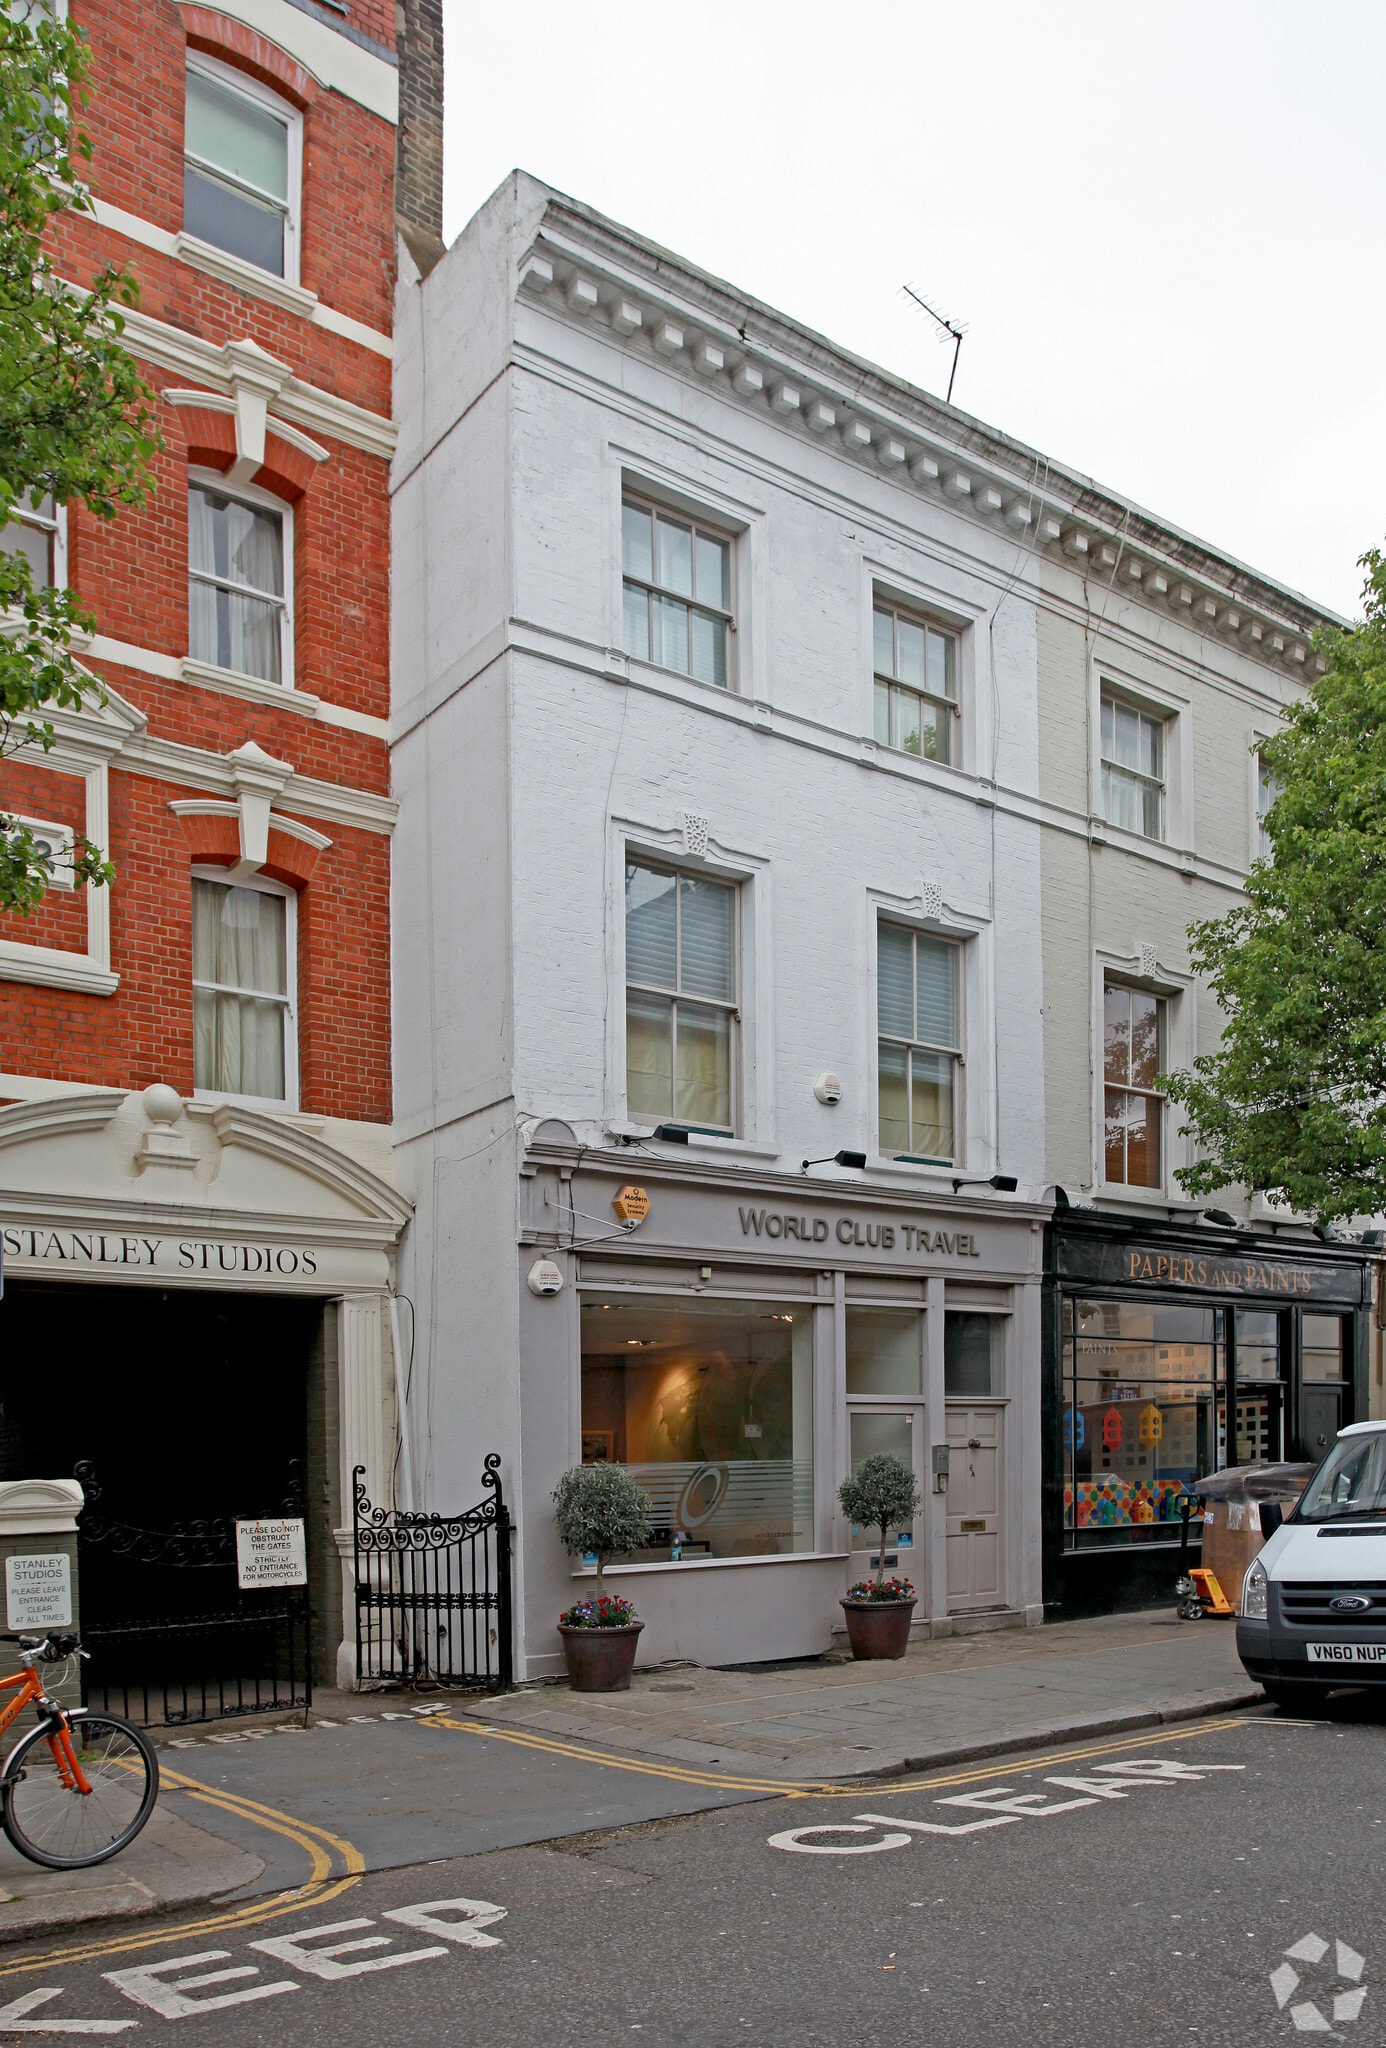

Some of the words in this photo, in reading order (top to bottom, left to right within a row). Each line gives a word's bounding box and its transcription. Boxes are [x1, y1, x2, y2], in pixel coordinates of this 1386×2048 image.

[624, 1193, 648, 1203] Modern
[626, 1202, 645, 1210] Security
[738, 1206, 830, 1242] WORLD
[836, 1217, 896, 1249] CLUB
[901, 1224, 981, 1257] TRAVEL
[2, 1228, 163, 1266] STANLEY
[178, 1242, 319, 1276] STUDIOS
[1129, 1253, 1208, 1285] PAPERS
[1211, 1269, 1243, 1287] AND
[1246, 1264, 1313, 1294] PAINTS
[1081, 1341, 1119, 1356] PAINTS
[240, 1526, 269, 1535] PLEASE
[284, 1525, 300, 1533] NOT
[251, 1534, 291, 1543] OBSTRUCT
[251, 1543, 266, 1551] THE
[267, 1542, 292, 1550] GATES
[13, 1559, 63, 1570] STANLEY
[254, 1555, 290, 1564] STRICTLY
[245, 1565, 257, 1573] NO
[259, 1563, 299, 1572] ENTRANCE
[14, 1569, 63, 1580] STUDIOS
[242, 1573, 256, 1581] FOR
[257, 1570, 303, 1579] MOTORCYCLES
[11, 1587, 41, 1596] PLEASE
[43, 1585, 67, 1593] LEAVE
[19, 1595, 60, 1605] ENTRANCE
[27, 1605, 53, 1613] CLEAR
[15, 1616, 24, 1624] AT
[26, 1615, 41, 1624] ALL
[42, 1613, 65, 1622] TIMES
[1313, 1645, 1353, 1661] VN60
[1357, 1646, 1386, 1662] NUP
[767, 1759, 1246, 1855] CLEAR
